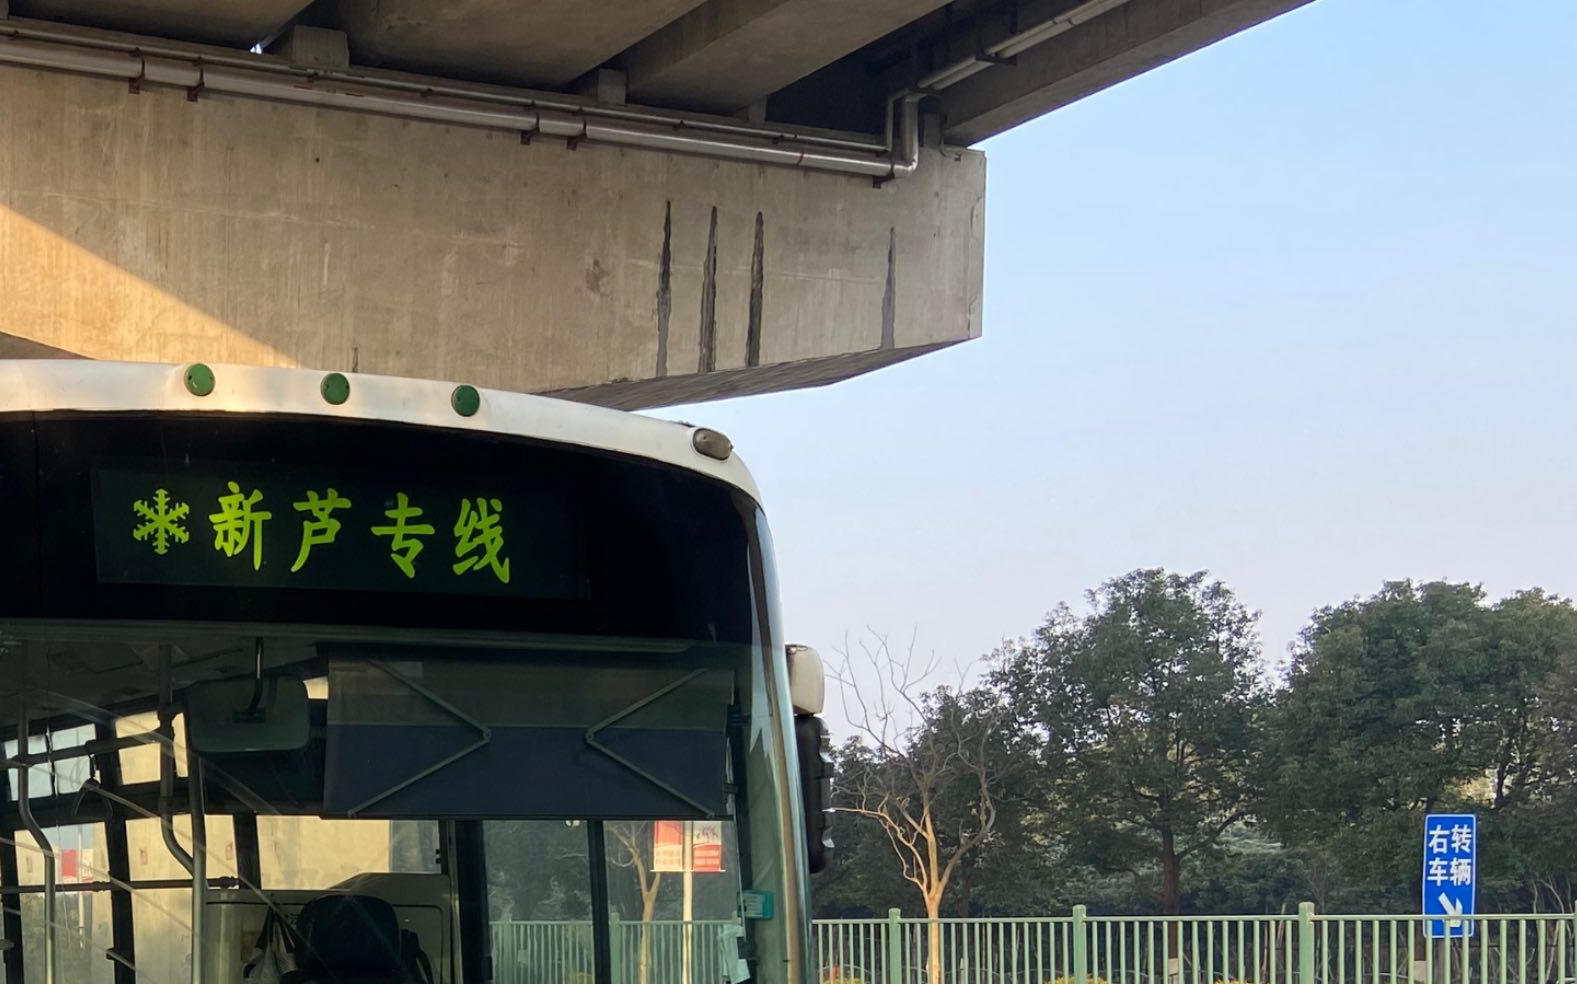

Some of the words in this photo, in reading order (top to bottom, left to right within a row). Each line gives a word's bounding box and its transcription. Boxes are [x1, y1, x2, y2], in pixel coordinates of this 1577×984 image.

[209, 481, 511, 584] 新芦专线
[1428, 823, 1472, 854] 右转
[1427, 857, 1472, 887] 车辆
